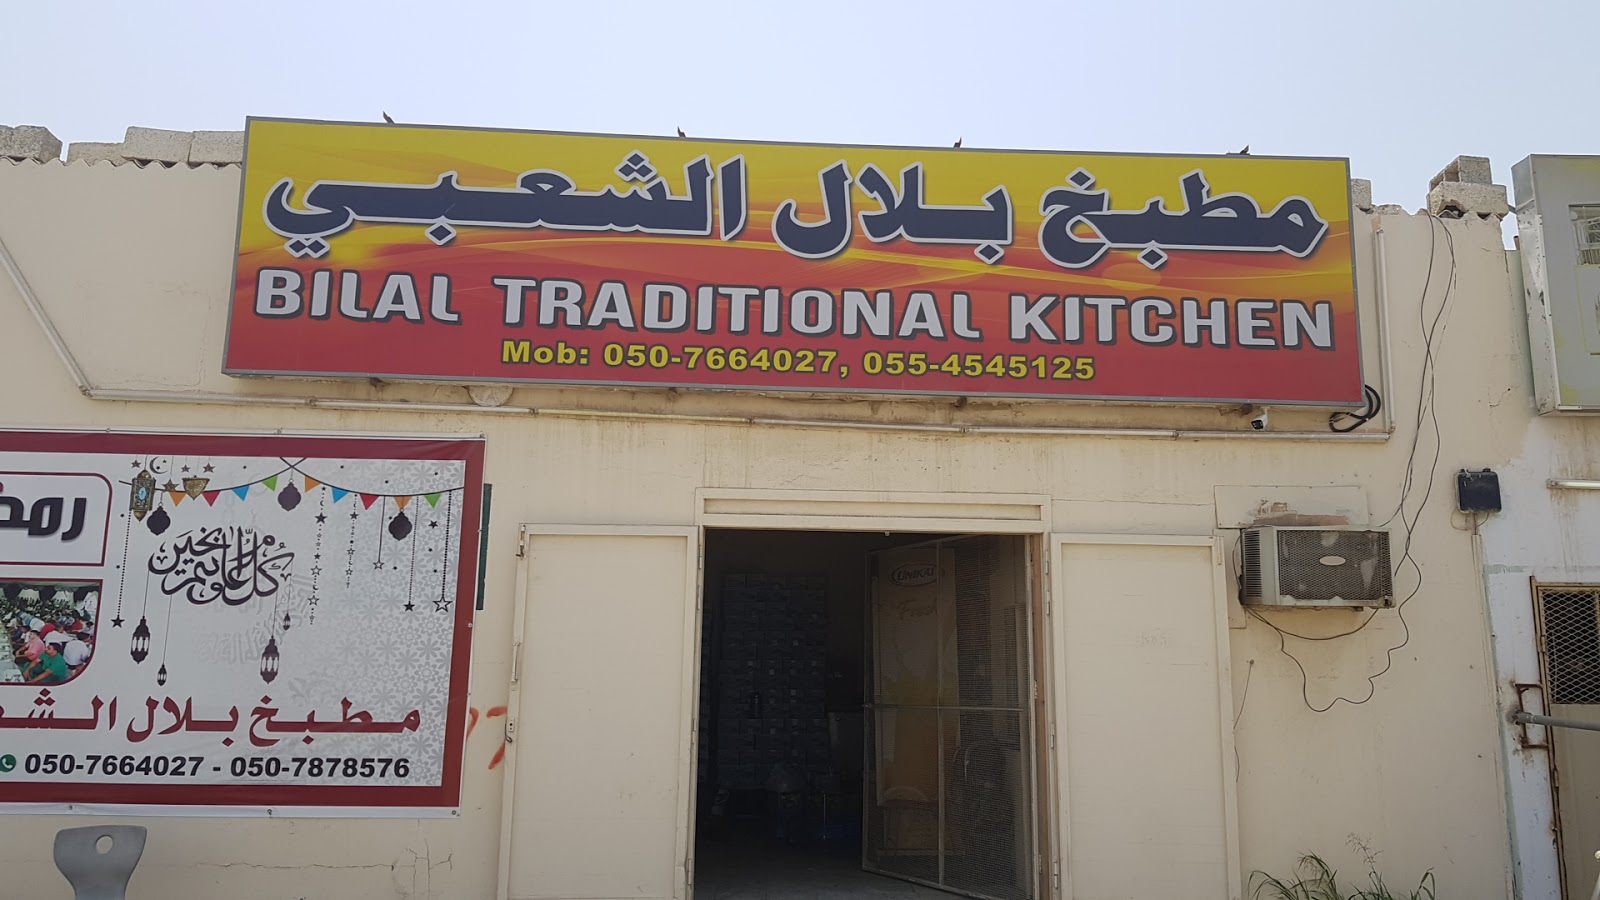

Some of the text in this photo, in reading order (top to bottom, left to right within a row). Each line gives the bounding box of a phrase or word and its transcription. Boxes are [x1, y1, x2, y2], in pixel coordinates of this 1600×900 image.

[263, 150, 1329, 269] مطبخ بلال الشعبي
[254, 267, 1336, 351] BILAL TRADITIONAL KITCHEN
[501, 339, 1096, 381] Mob: 050-7664027, 055-4545125
[126, 695, 239, 747] بلال
[248, 694, 421, 747] مطبخ
[24, 753, 204, 777] 050-7664027
[230, 755, 411, 779] 050-7878576
